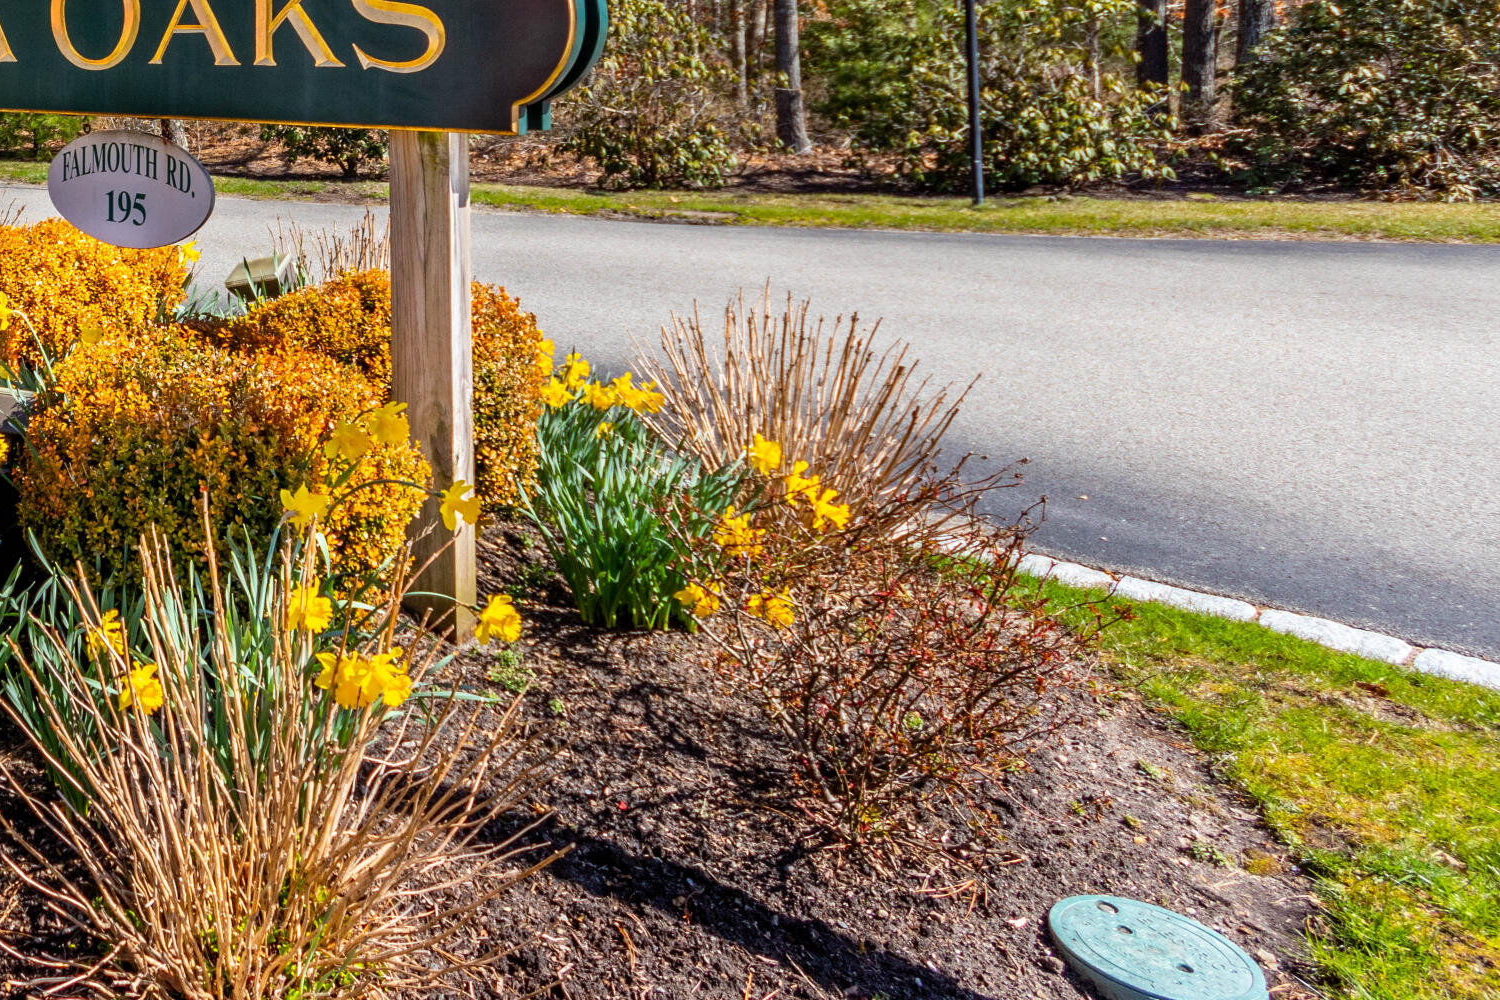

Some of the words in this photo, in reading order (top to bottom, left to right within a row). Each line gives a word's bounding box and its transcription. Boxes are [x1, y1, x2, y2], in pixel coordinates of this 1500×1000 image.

[62, 142, 158, 182] FALMOUTH
[165, 153, 195, 199] RD.
[105, 190, 147, 226] 195
